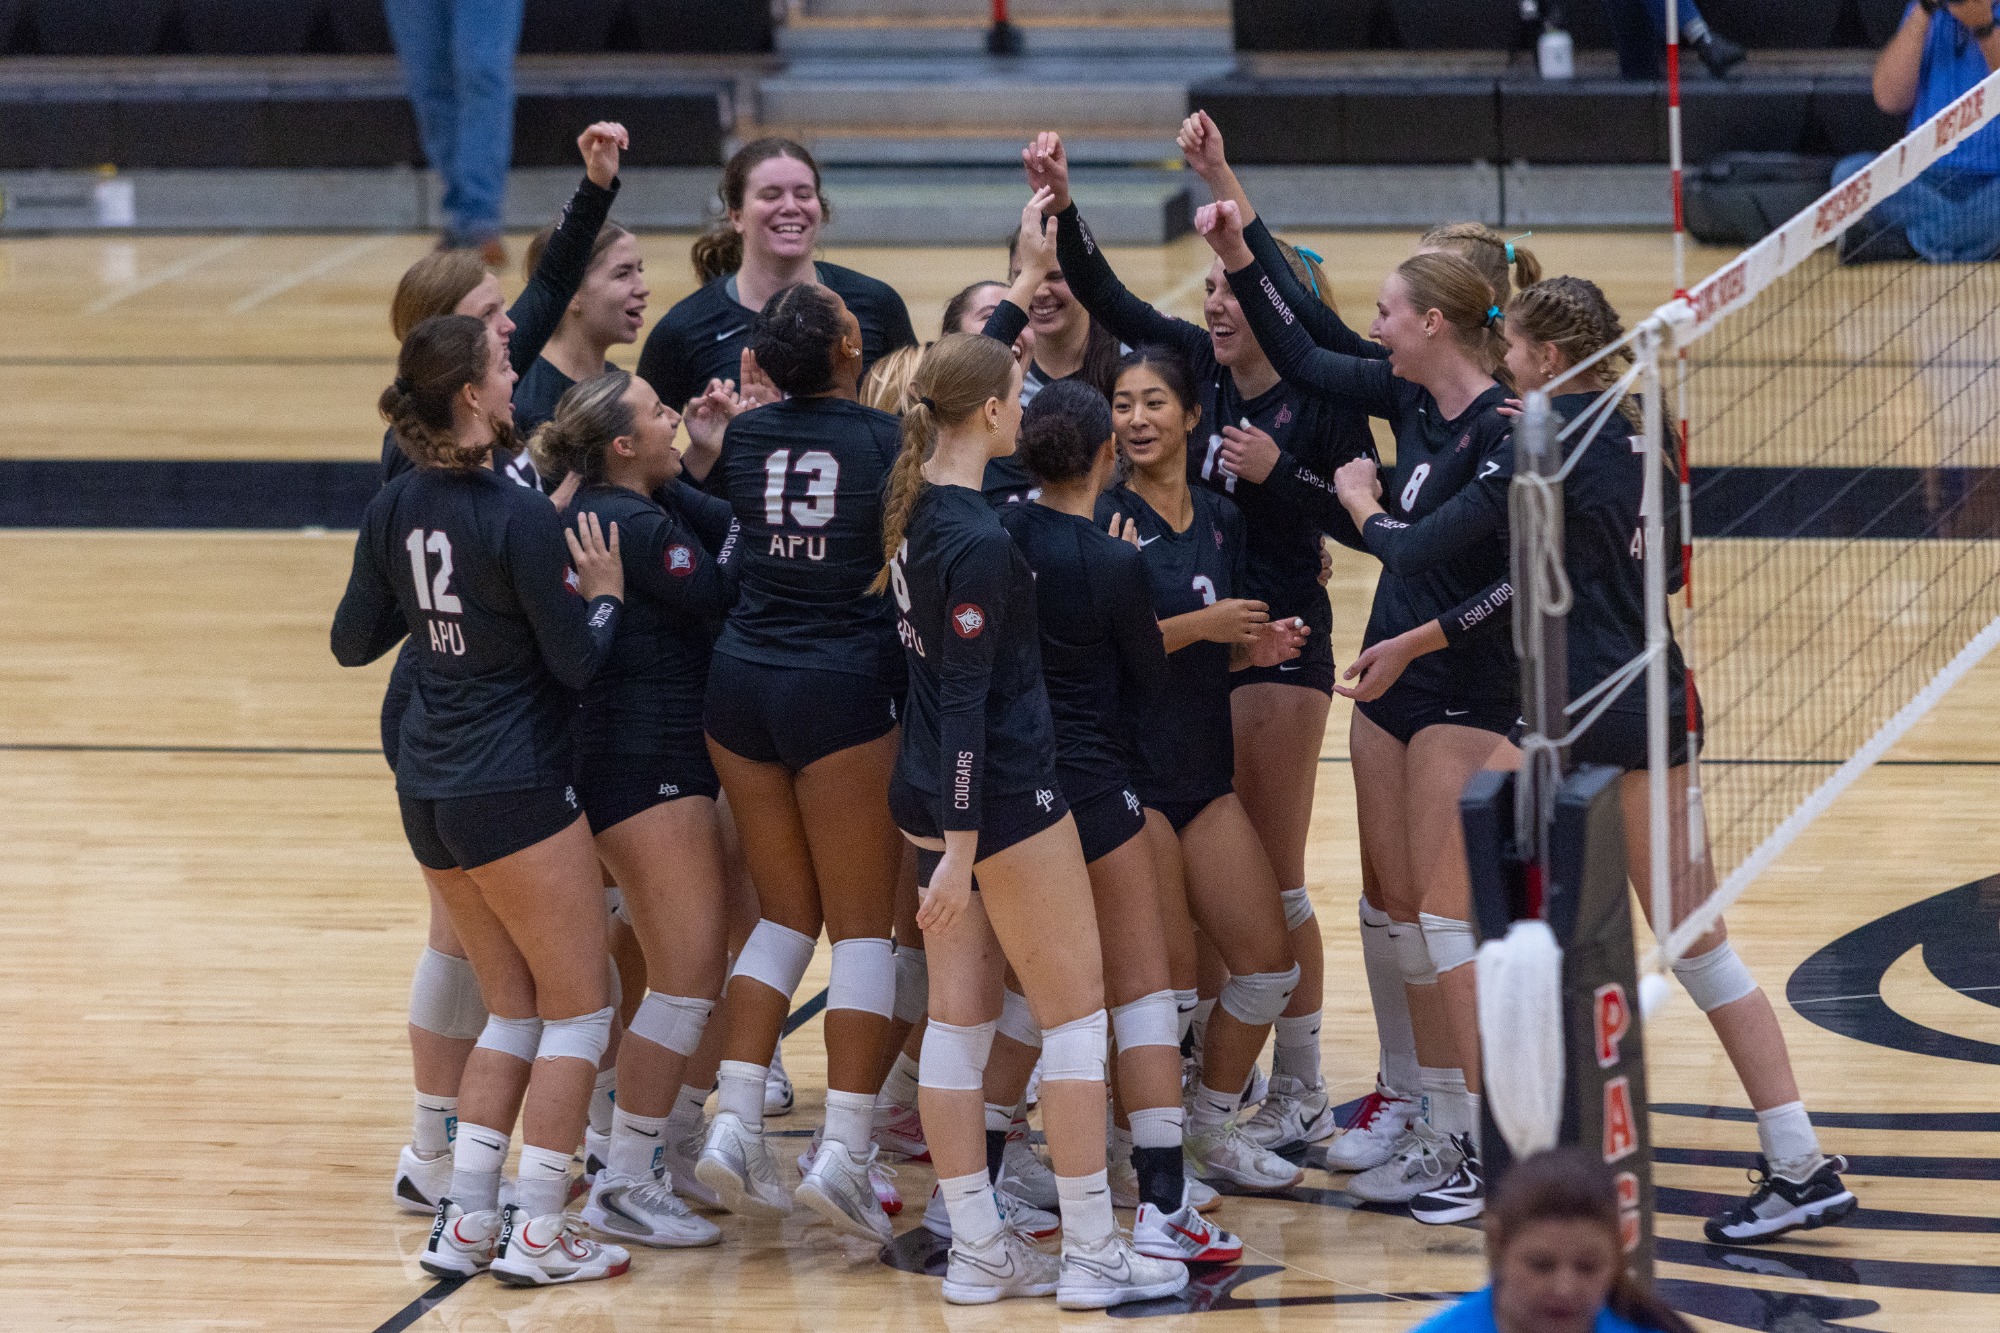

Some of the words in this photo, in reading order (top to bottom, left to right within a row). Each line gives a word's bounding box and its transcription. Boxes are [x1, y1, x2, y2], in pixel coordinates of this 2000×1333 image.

[1260, 275, 1295, 325] COUGARS
[764, 448, 839, 529] 13
[1400, 462, 1431, 512] 8
[405, 528, 463, 614] 12
[768, 534, 826, 560] APU
[1457, 599, 1494, 631] FIRST
[1489, 582, 1515, 607] GOD
[428, 619, 466, 656] APU
[954, 750, 974, 810] COUGARS
